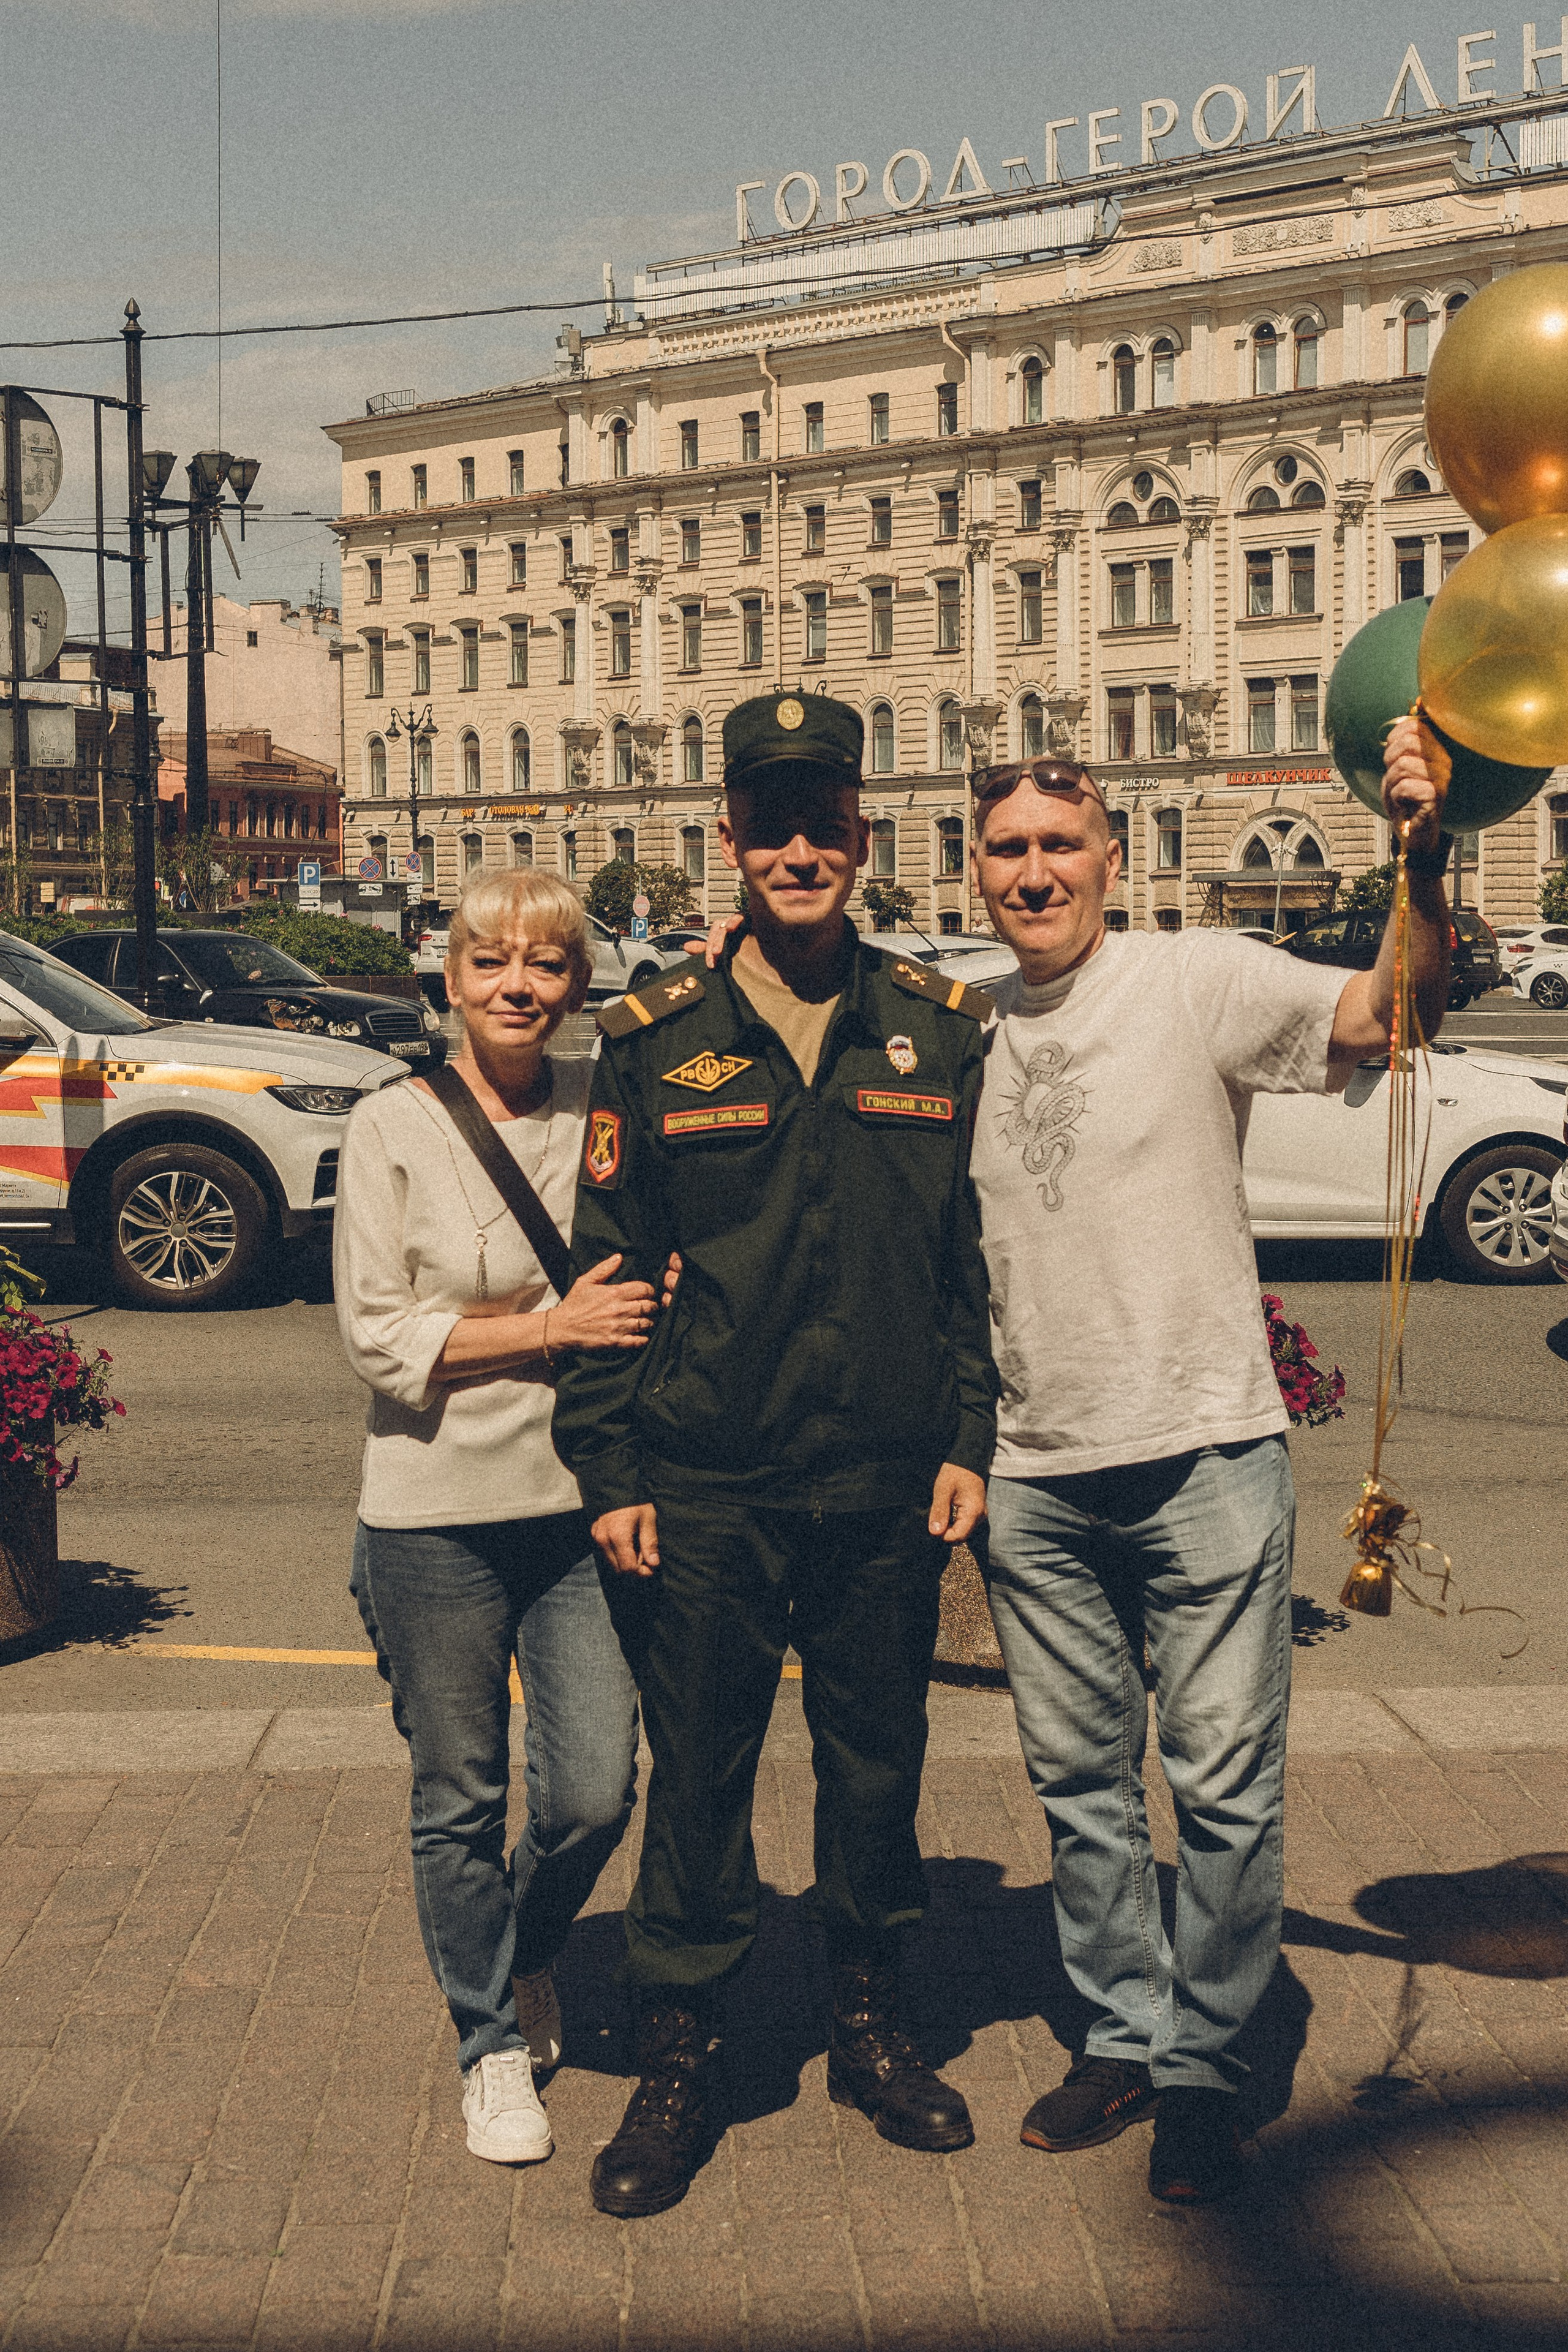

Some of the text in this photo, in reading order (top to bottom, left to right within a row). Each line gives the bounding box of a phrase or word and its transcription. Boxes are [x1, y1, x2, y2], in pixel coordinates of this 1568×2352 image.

[1120, 777, 1160, 788] БИСТРО
[1226, 767, 1332, 785] ЩЕЛКУНЧИК
[489, 805, 525, 815] СТОЛОВАЯ
[304, 865, 316, 884] P
[636, 919, 645, 937] P
[865, 1096, 946, 1115] ГОНСКИЙ М.А.
[668, 1109, 764, 1130] ВООРУЖЕННЫЕ СИЛЫ РОССИИ
